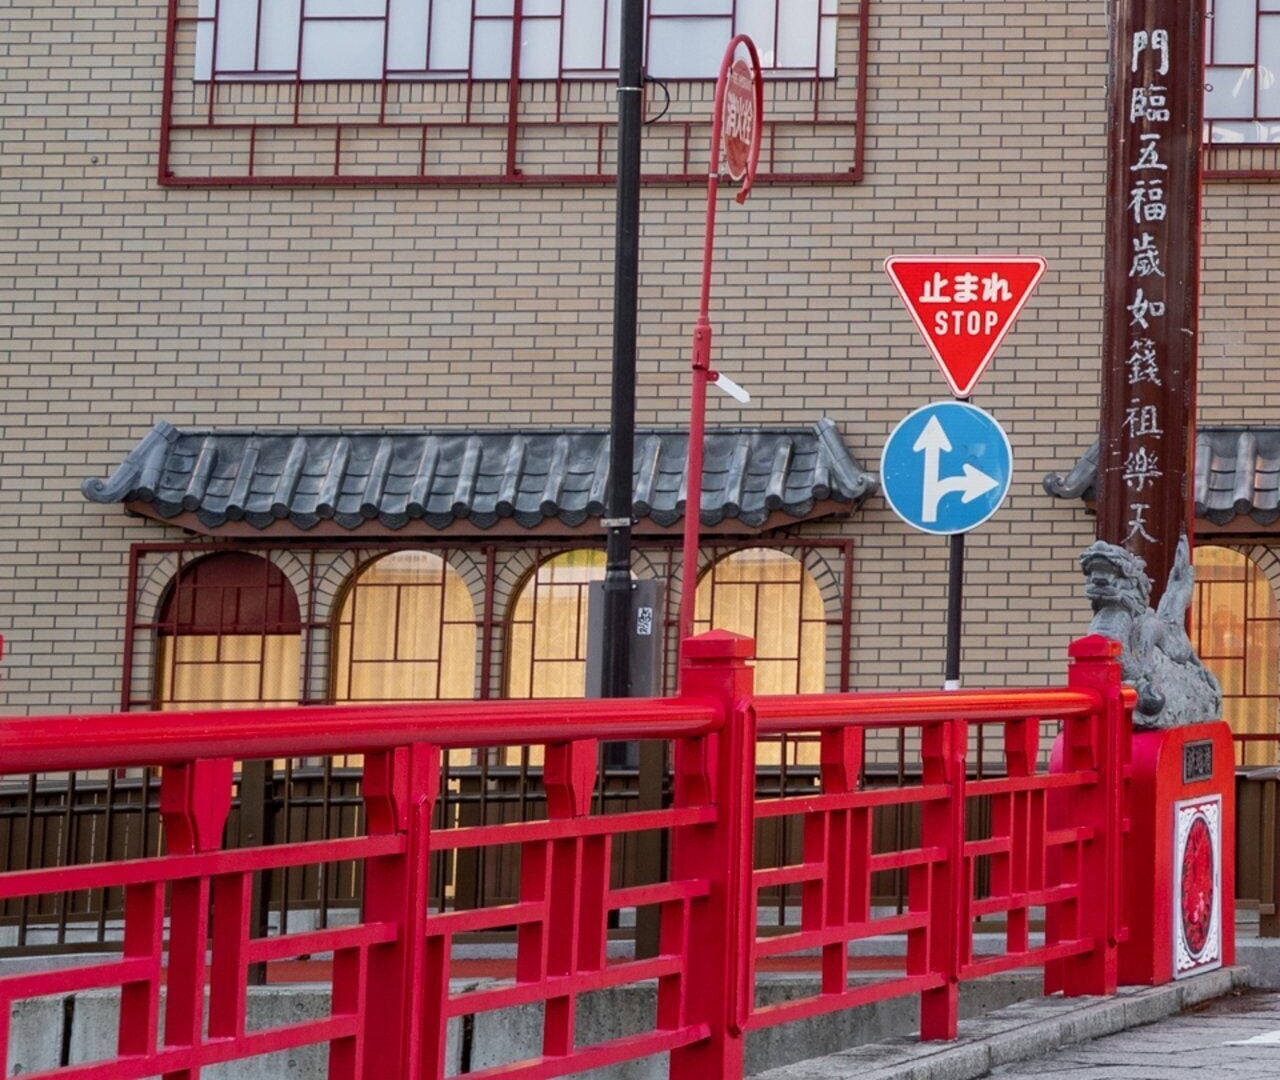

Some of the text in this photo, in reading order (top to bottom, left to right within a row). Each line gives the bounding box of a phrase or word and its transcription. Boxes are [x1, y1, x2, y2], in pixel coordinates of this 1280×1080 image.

[919, 272, 1013, 303] 止まれ
[935, 310, 998, 335] STOP
